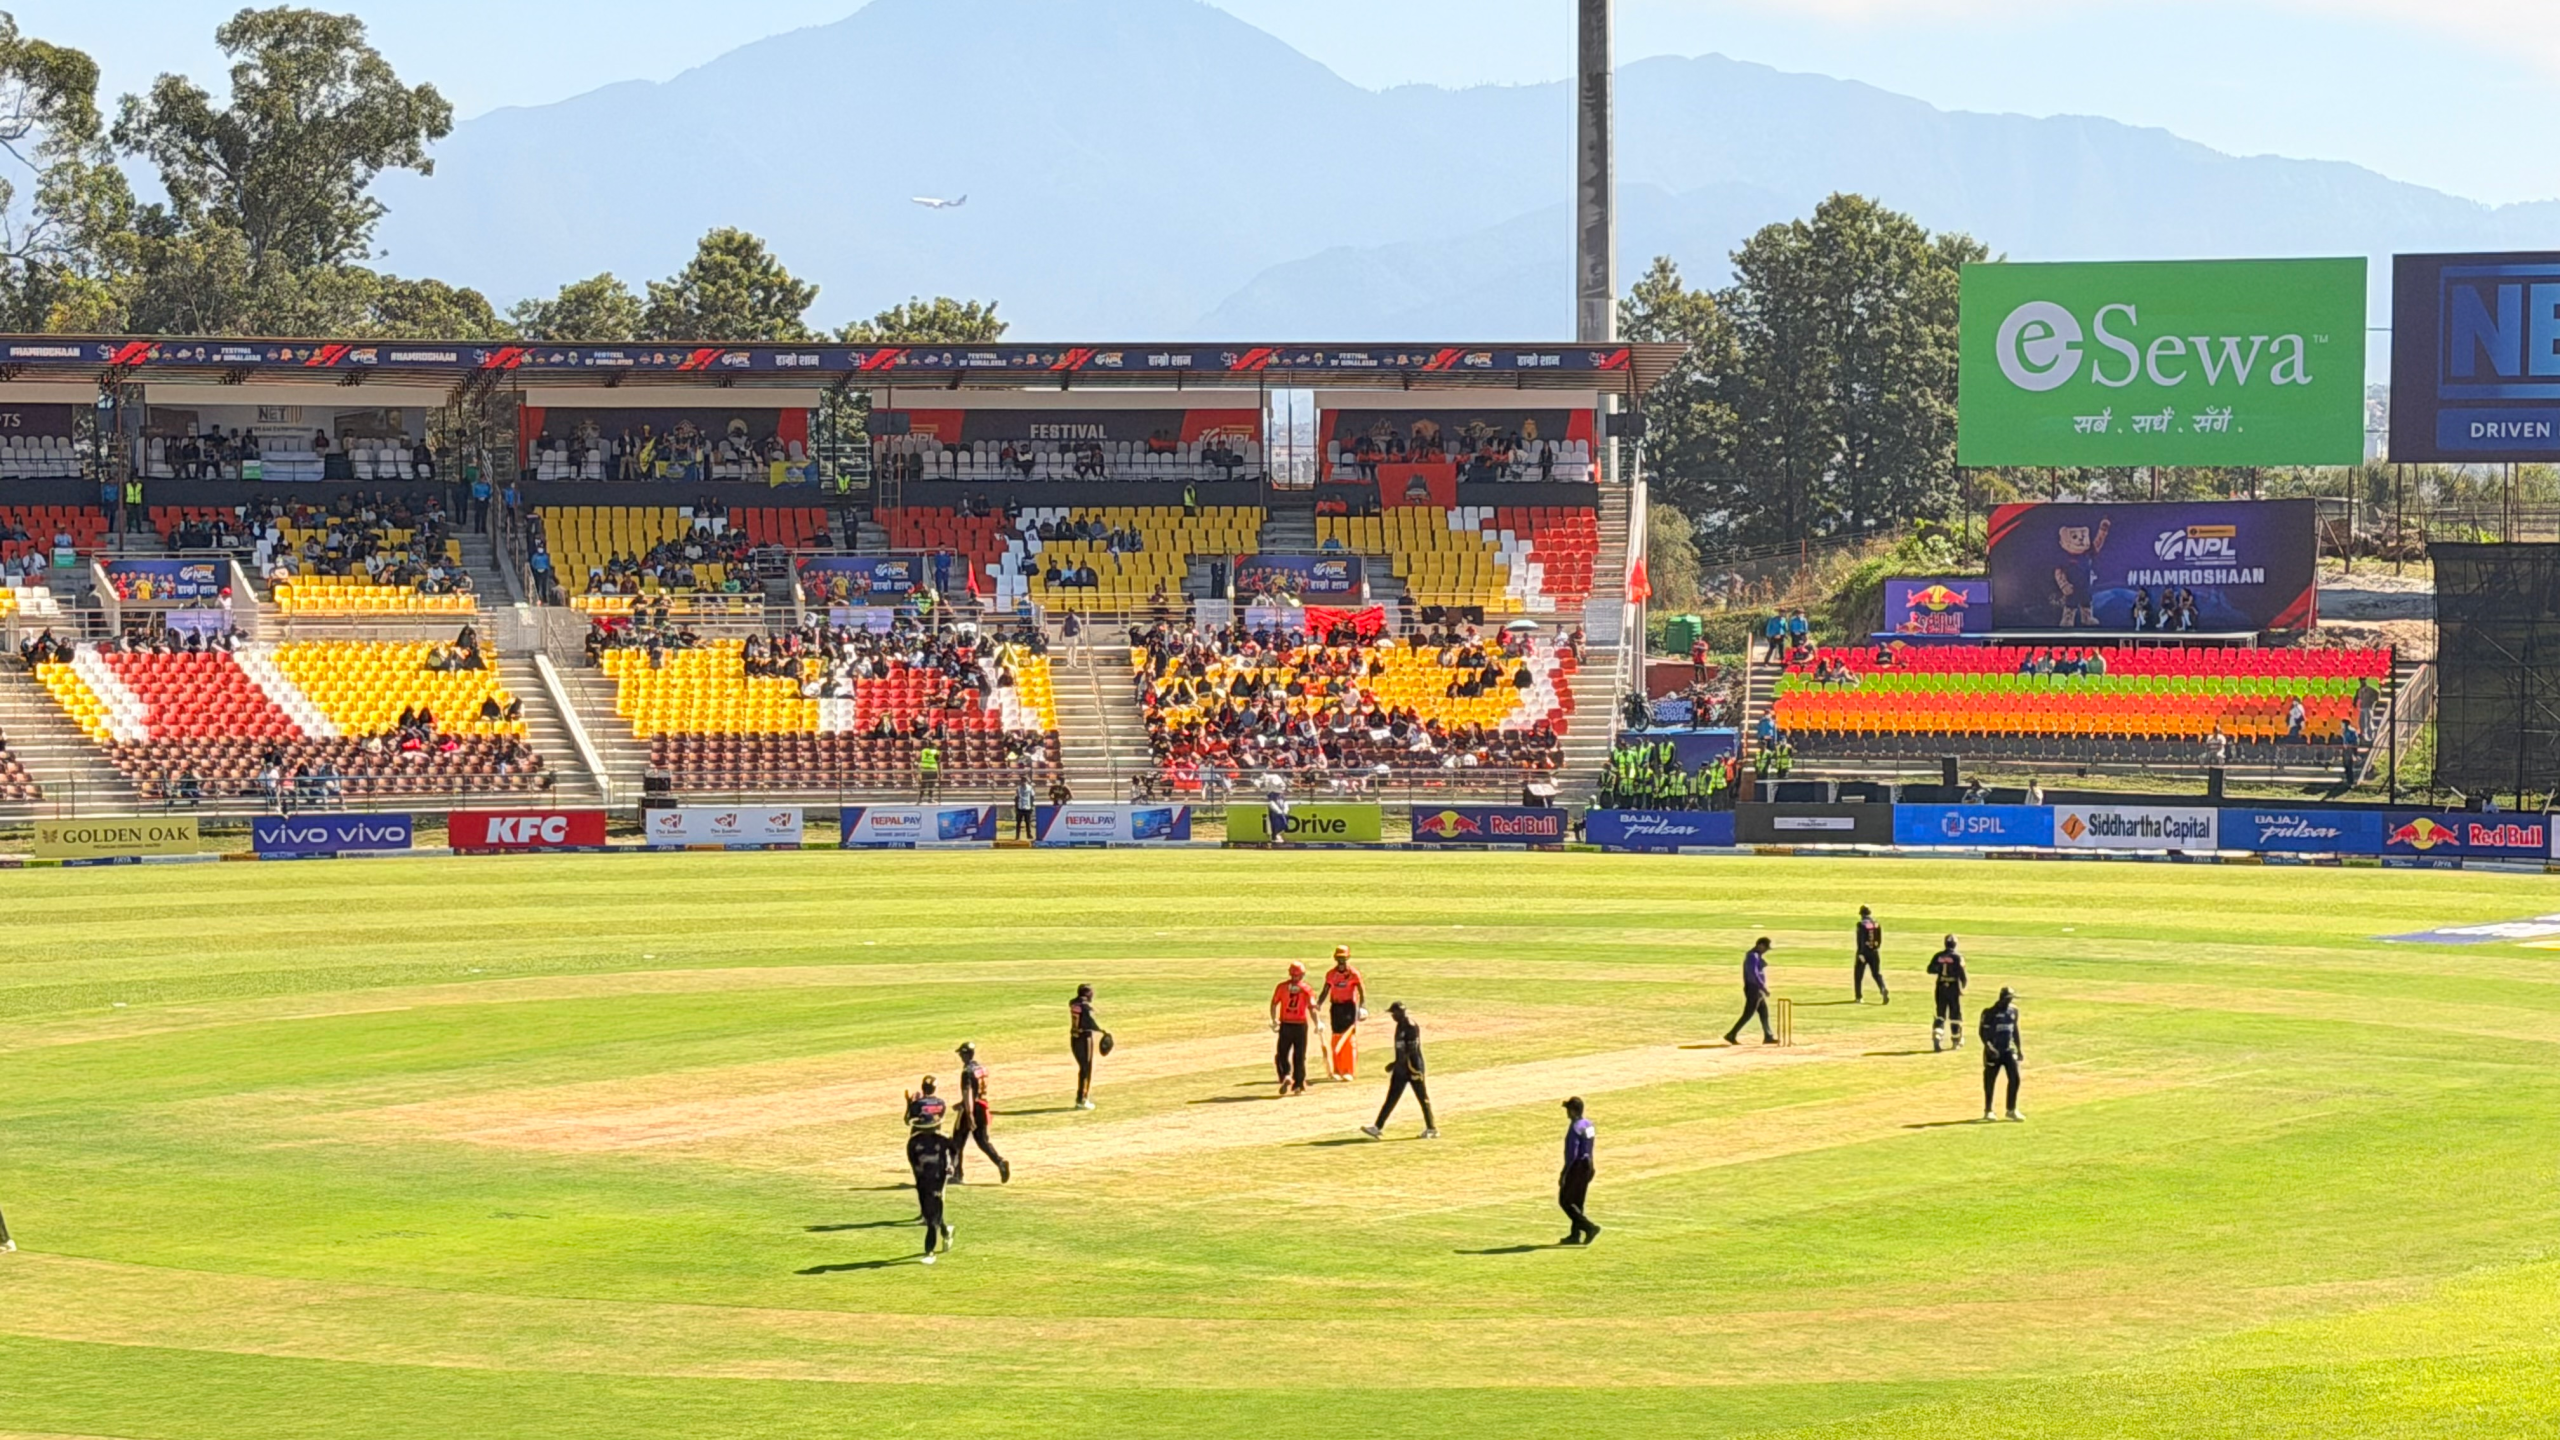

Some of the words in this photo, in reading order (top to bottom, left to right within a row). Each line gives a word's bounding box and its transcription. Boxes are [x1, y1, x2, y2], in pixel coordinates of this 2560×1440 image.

[1996, 300, 2313, 391] eSewa
[1030, 424, 1107, 439] FESTIVAL
[2470, 422, 2551, 438] DRIVEN
[2184, 537, 2236, 556] NPL
[2127, 567, 2265, 586] #HAMROSHAAN
[1262, 814, 1346, 833] iDrive
[1490, 815, 1523, 835] Red
[1525, 815, 1557, 836] Bull
[1620, 814, 1660, 823] BAJAJ
[1968, 816, 2006, 833] SPIL
[2088, 813, 2161, 838] Siddhartha
[2164, 815, 2210, 843] Capital
[2255, 815, 2299, 824] BAJAJ
[63, 828, 141, 844] GOLDEN
[149, 827, 189, 841] OAK
[258, 824, 328, 844] vivo
[337, 822, 406, 842] vivo
[485, 816, 568, 843] KFC
[2468, 823, 2504, 846] Red
[2507, 824, 2543, 847] Bull
